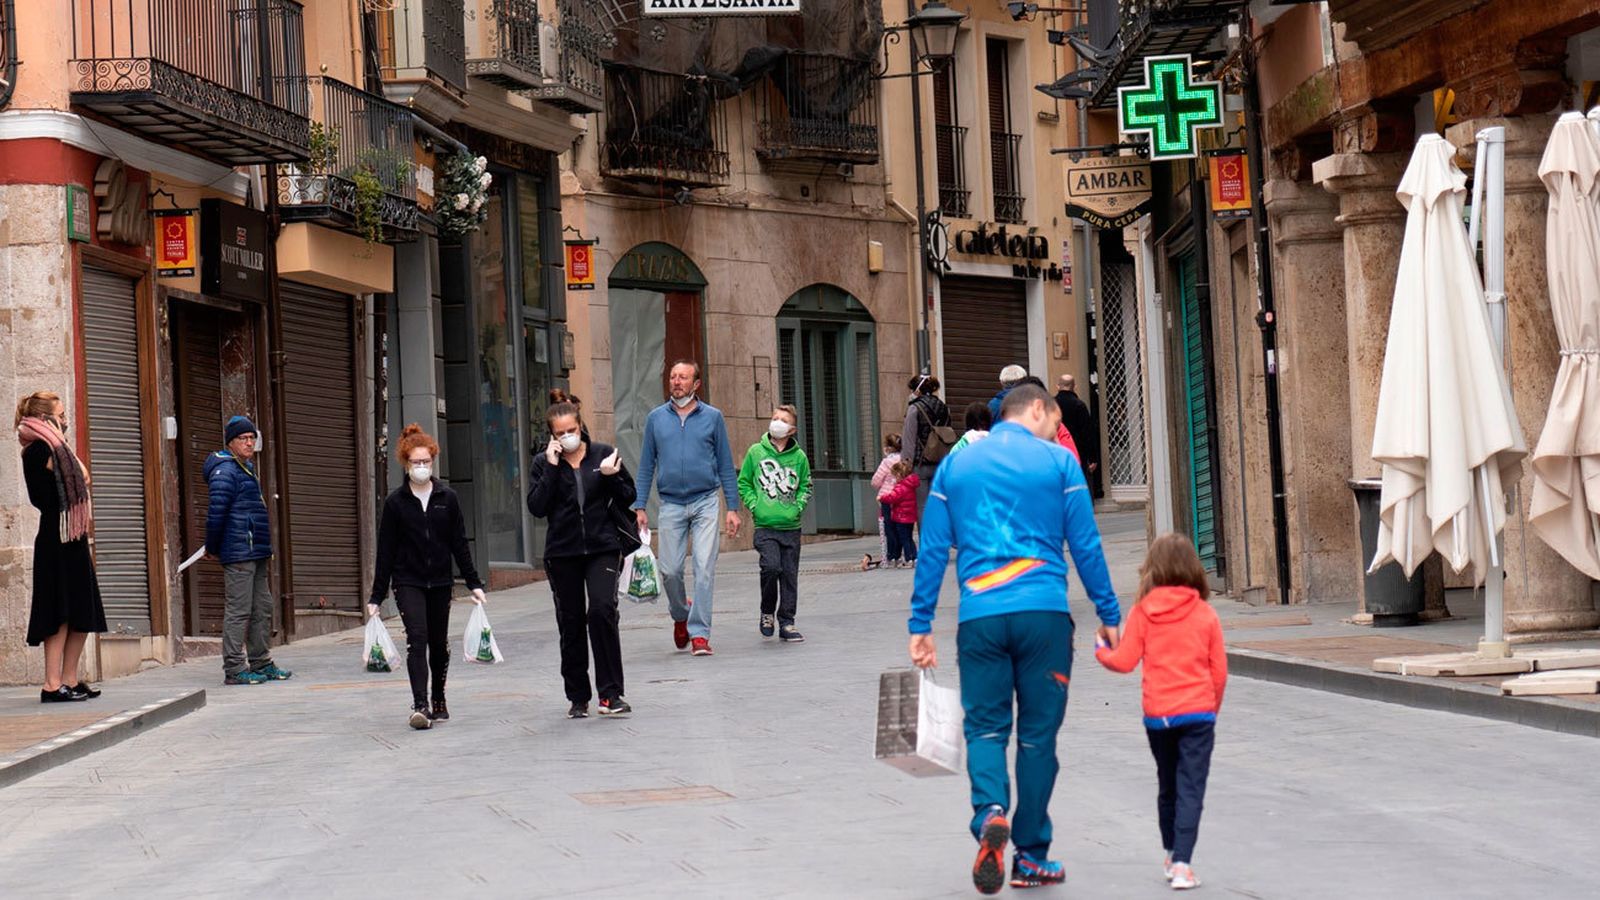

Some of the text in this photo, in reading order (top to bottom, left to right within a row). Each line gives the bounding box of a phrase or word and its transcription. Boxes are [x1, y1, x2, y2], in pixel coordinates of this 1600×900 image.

[1076, 170, 1147, 190] AMBAR
[1082, 210, 1142, 229] PURA CEPA
